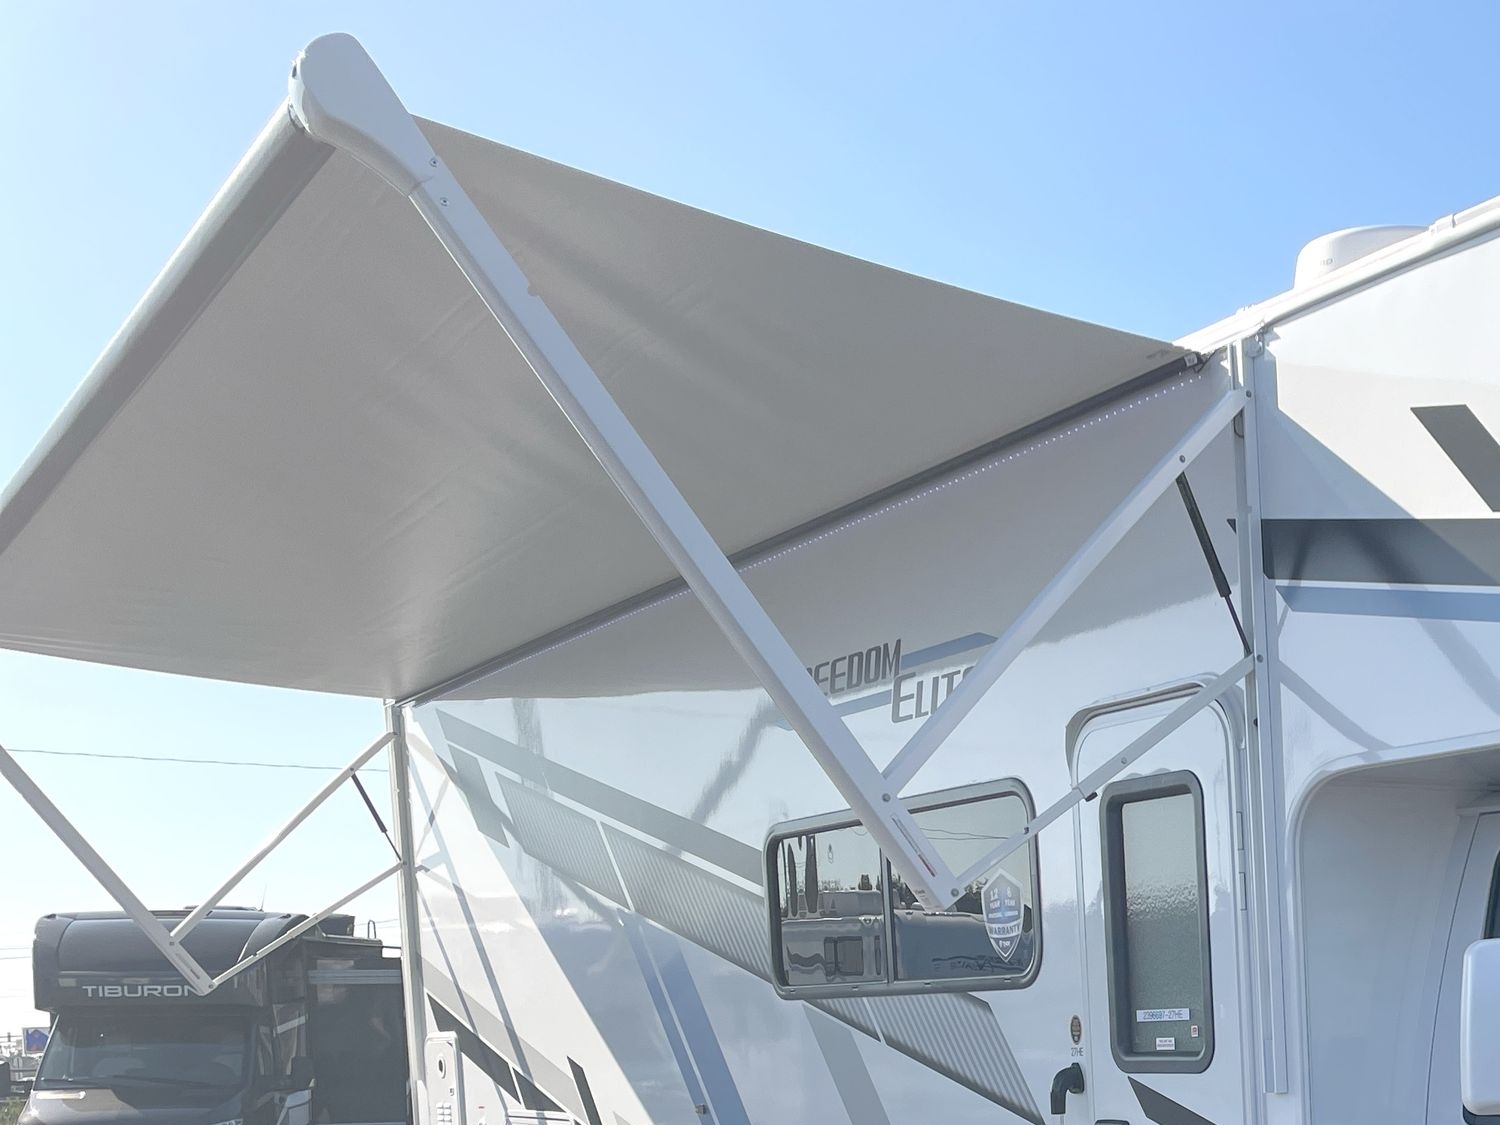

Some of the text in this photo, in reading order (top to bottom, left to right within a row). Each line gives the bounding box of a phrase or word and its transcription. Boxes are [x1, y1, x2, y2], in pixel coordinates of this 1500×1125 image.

[806, 638, 902, 696] EEDOM
[891, 665, 976, 724] ELIT
[987, 923, 1021, 935] WARRANTY
